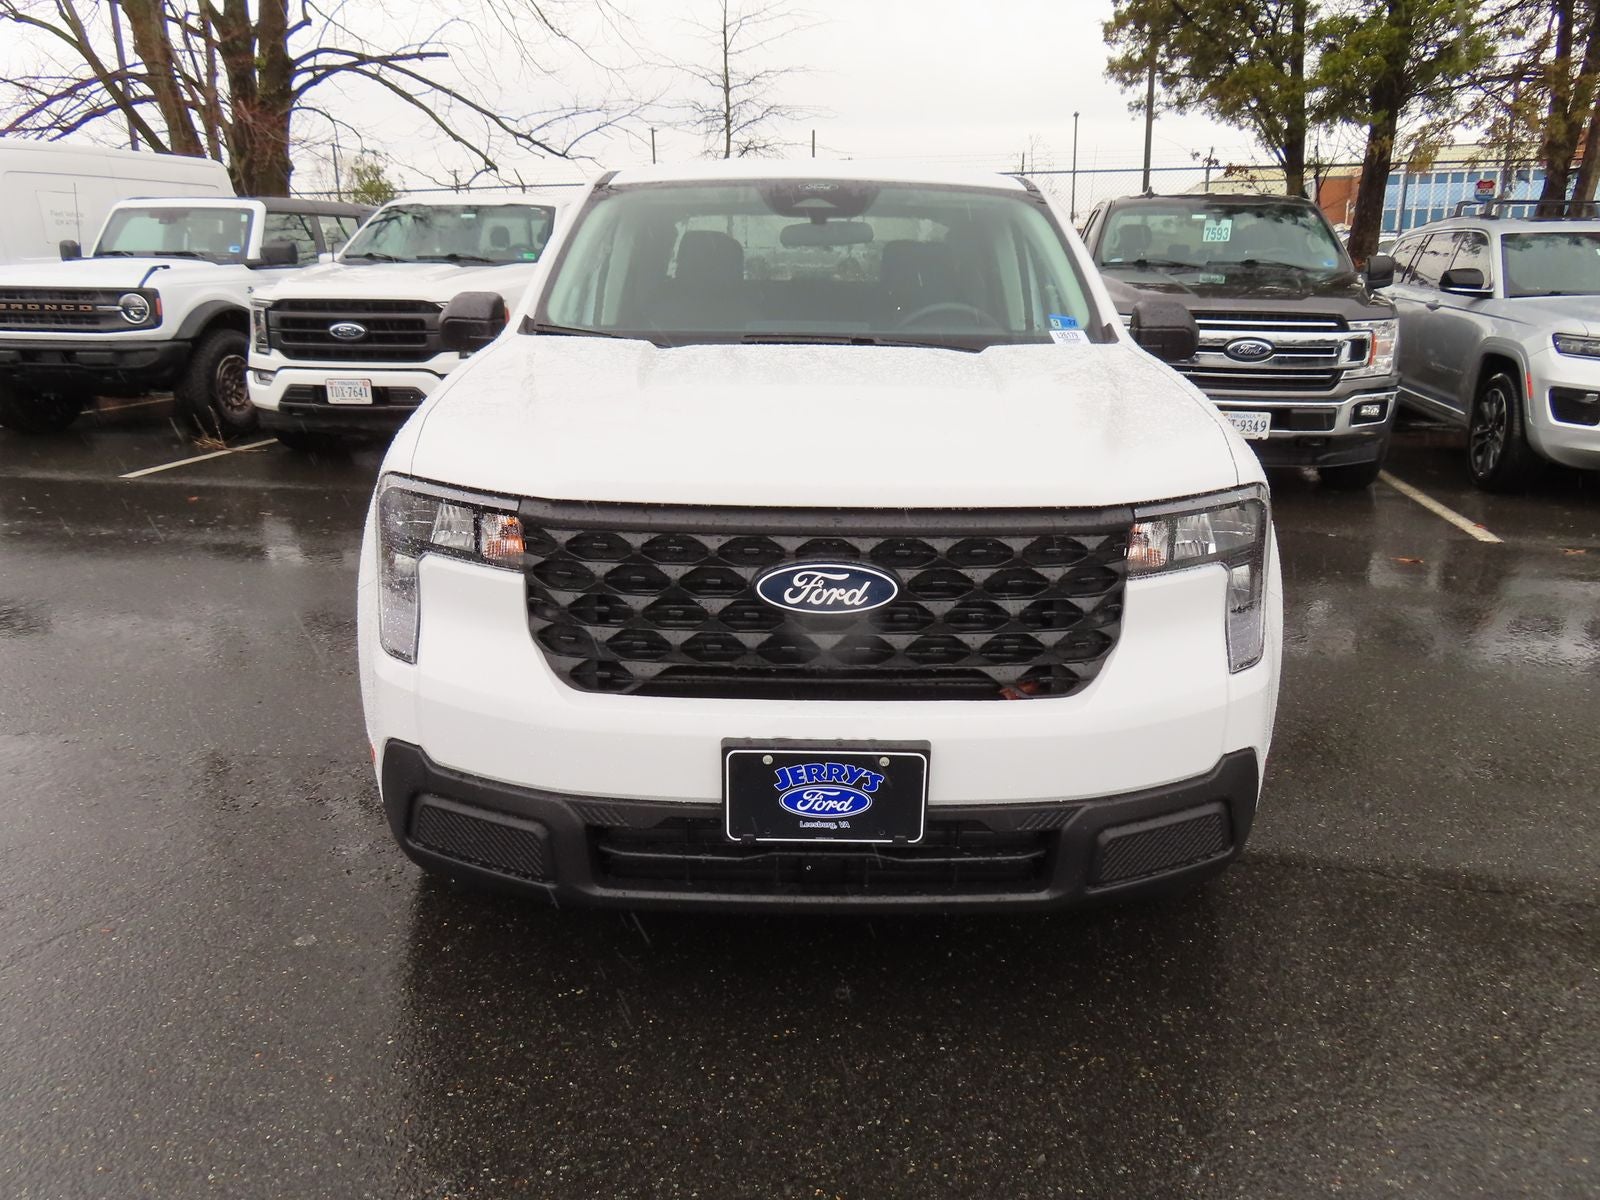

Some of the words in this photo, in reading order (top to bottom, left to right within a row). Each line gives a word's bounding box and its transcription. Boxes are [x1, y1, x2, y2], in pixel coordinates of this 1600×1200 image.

[1205, 226, 1230, 241] 7593
[1238, 343, 1263, 355] Ford
[329, 386, 369, 398] TDX-7641
[1228, 419, 1267, 432] T-9349
[783, 570, 872, 606] Ford
[774, 762, 885, 792] JERRY'S
[796, 789, 854, 812] Ford
[800, 820, 838, 830] Leesburg,
[838, 820, 851, 829] VA
